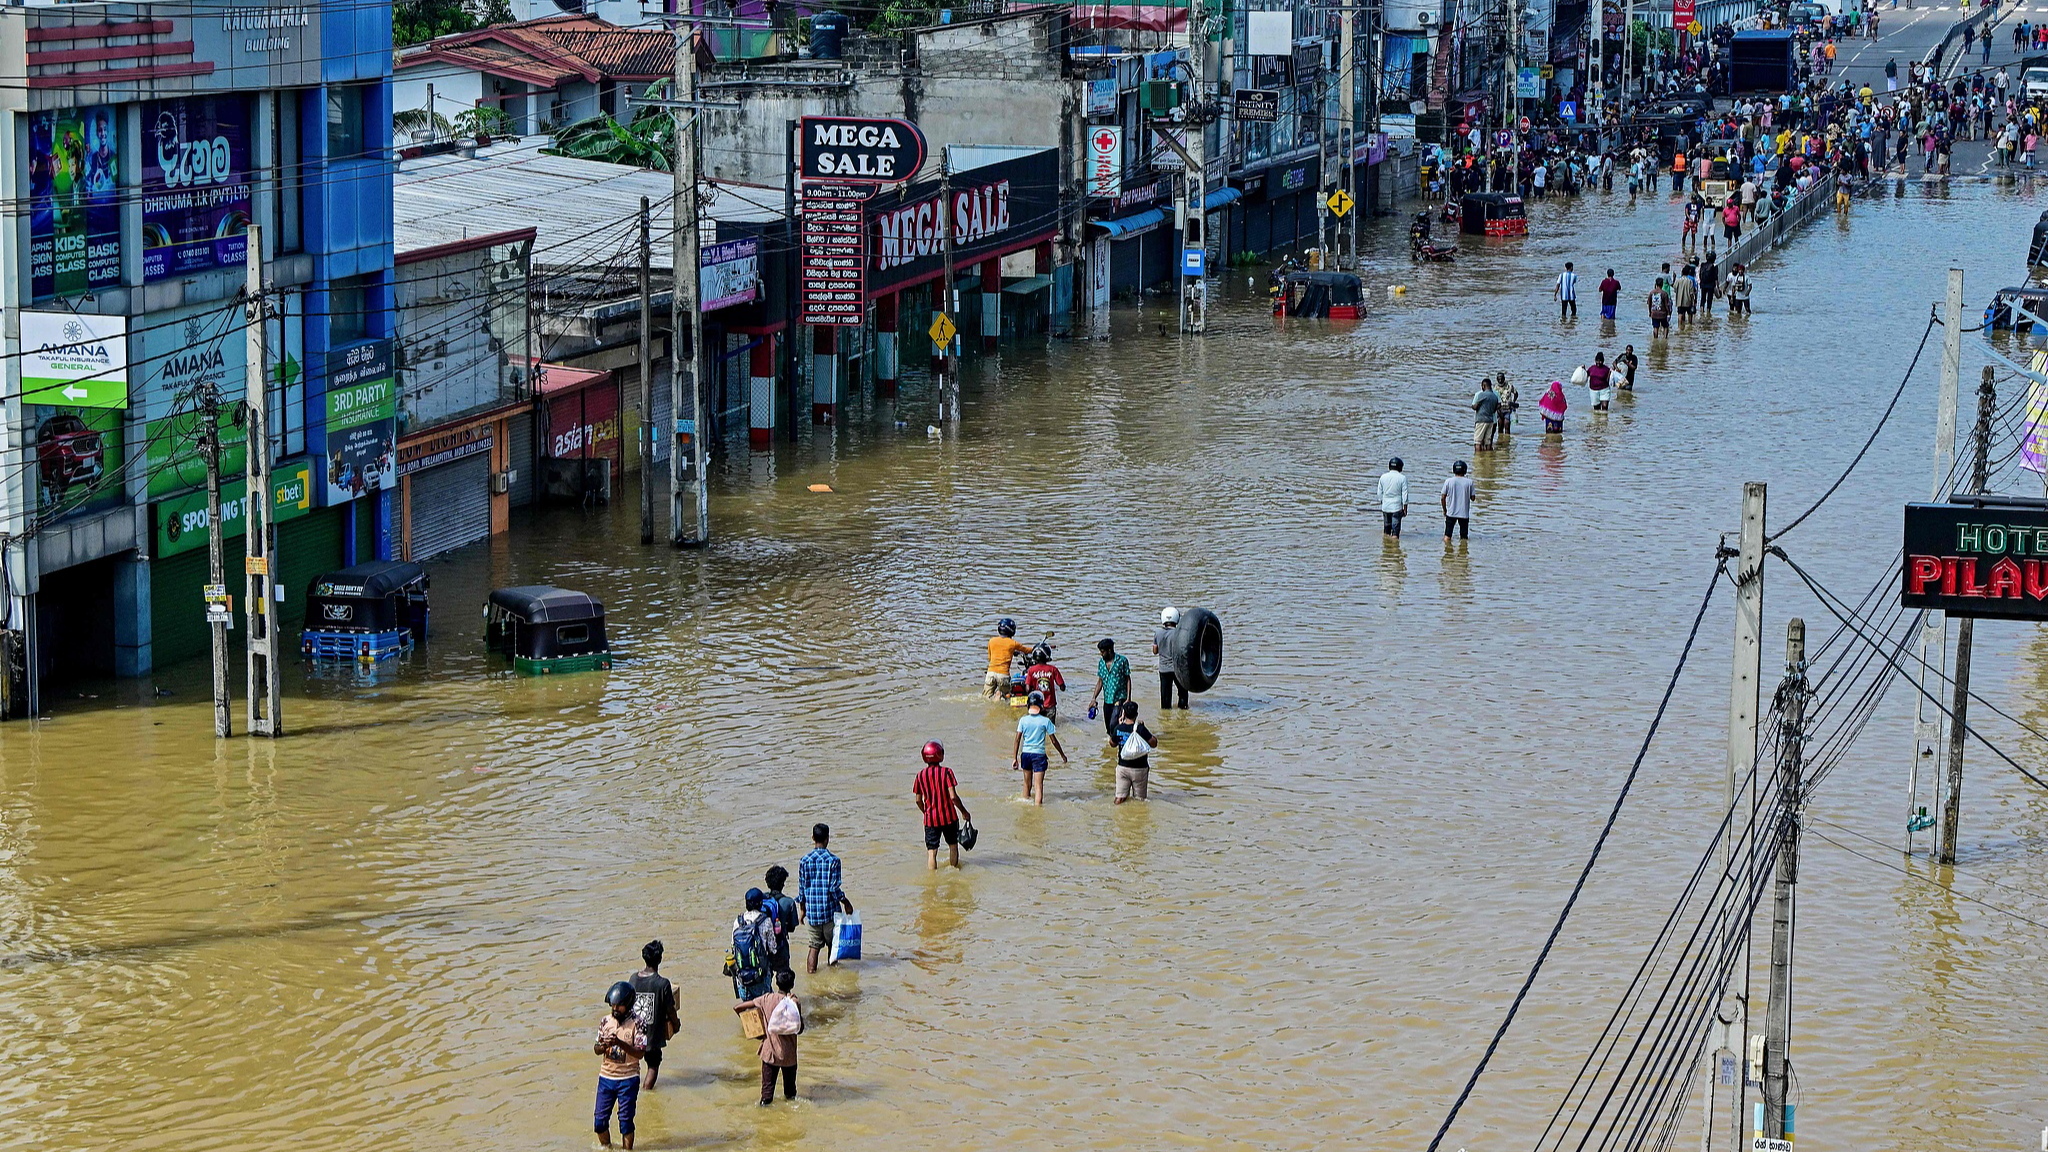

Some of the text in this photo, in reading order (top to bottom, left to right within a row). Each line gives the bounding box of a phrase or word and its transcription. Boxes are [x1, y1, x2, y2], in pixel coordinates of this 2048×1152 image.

[245, 37, 290, 52] BUILDING
[1238, 108, 1275, 117] PREMIER
[814, 124, 901, 148] MEGA
[817, 152, 896, 177] SALE
[145, 193, 193, 213] DHENUMA
[209, 186, 233, 207] (PVT)
[234, 185, 250, 200] LTD
[807, 189, 832, 197] 9.00am
[838, 190, 867, 199] 11.00pm
[879, 179, 1010, 271] MEGA SALE
[31, 241, 52, 252] APHIC
[55, 234, 85, 252] KIDS
[88, 242, 119, 258] BASIC
[31, 252, 52, 265] SIGN
[55, 250, 86, 261] COMPUTER
[88, 257, 119, 268] COMPUTER
[143, 254, 163, 264] OMPUTER
[31, 265, 53, 278] LASS
[55, 259, 86, 273] CLASS
[88, 266, 120, 281] CLASS
[143, 264, 165, 276] ASSES
[40, 343, 108, 357] AMANA
[51, 363, 97, 371] GENERAL
[162, 349, 225, 380] AMANA
[334, 382, 387, 412] 3RD PARTY
[341, 404, 380, 425] INSURANCE
[430, 429, 472, 451] LIGHTS
[276, 483, 299, 504] stbet
[182, 500, 238, 533] SPOING
